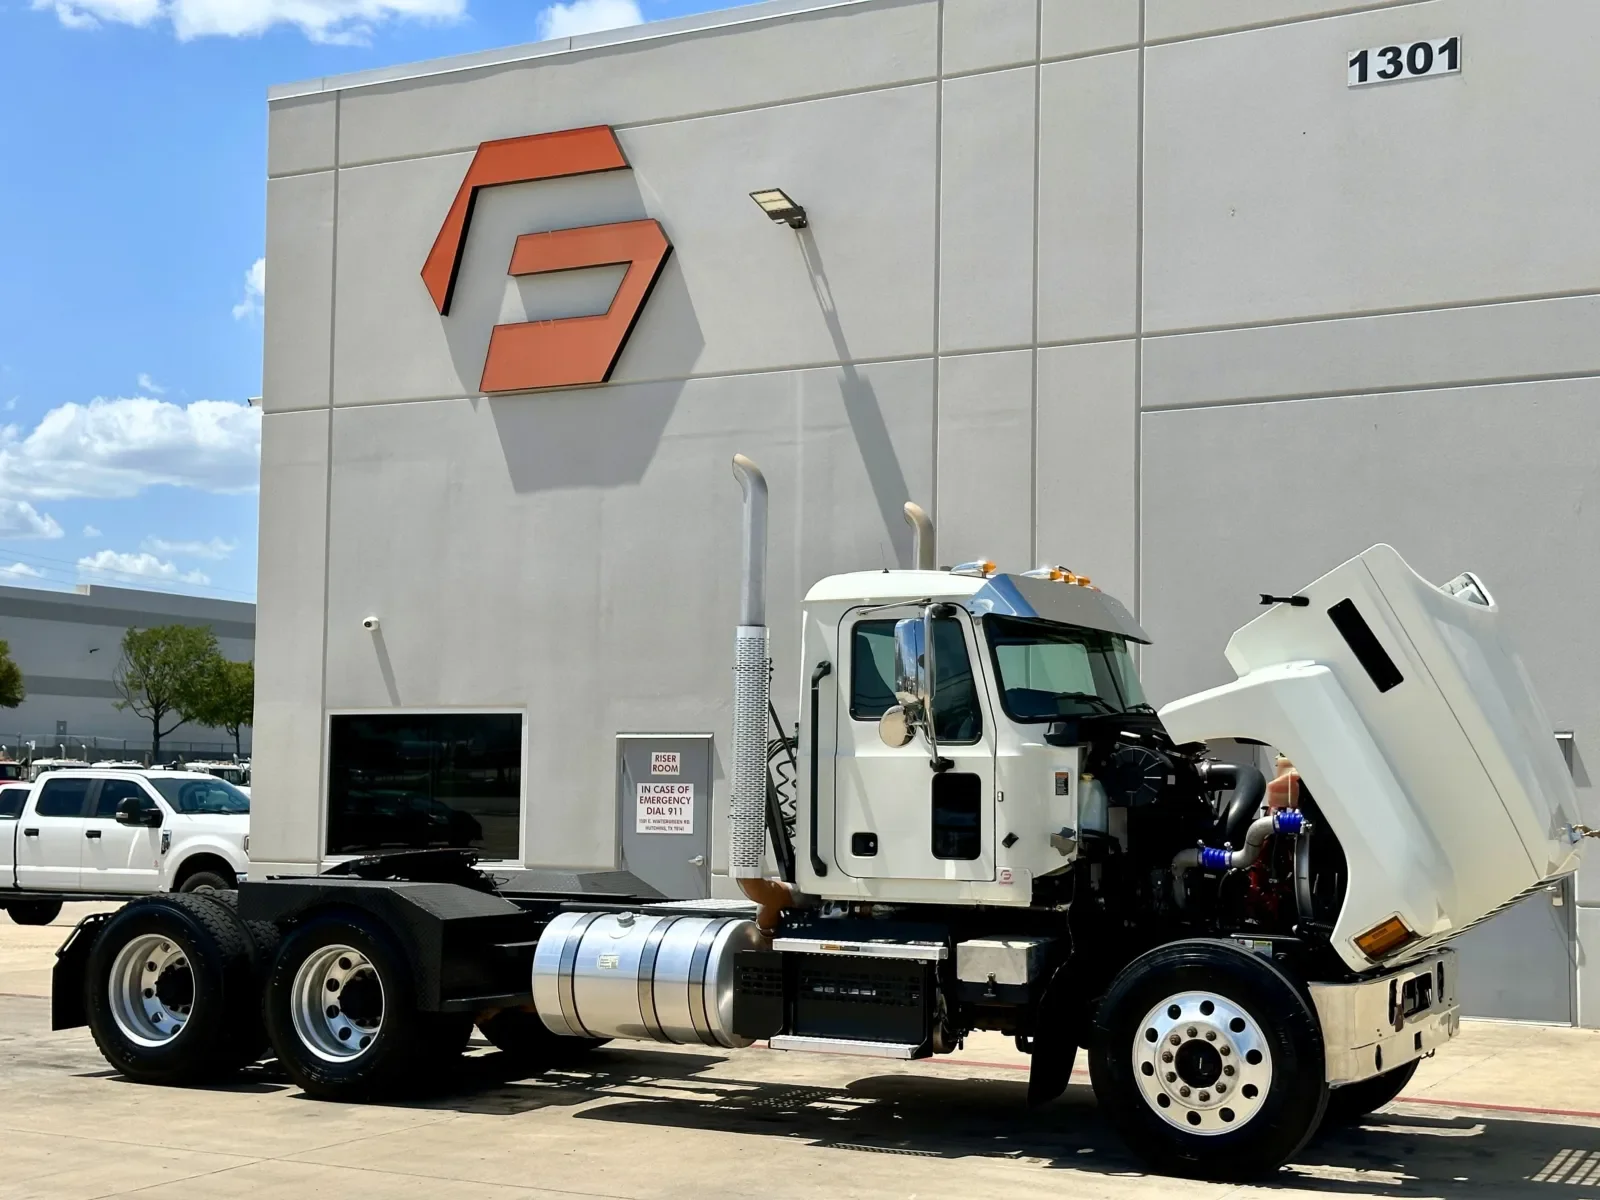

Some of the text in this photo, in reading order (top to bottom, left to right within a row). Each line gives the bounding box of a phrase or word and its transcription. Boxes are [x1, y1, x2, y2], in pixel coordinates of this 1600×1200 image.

[1349, 37, 1458, 83] 1301
[655, 754, 677, 763] RISER
[652, 764, 679, 772] ROOM
[641, 785, 690, 794] IN CASE OF
[639, 796, 691, 805] EMERGENCY
[646, 806, 683, 816] DIAL 911
